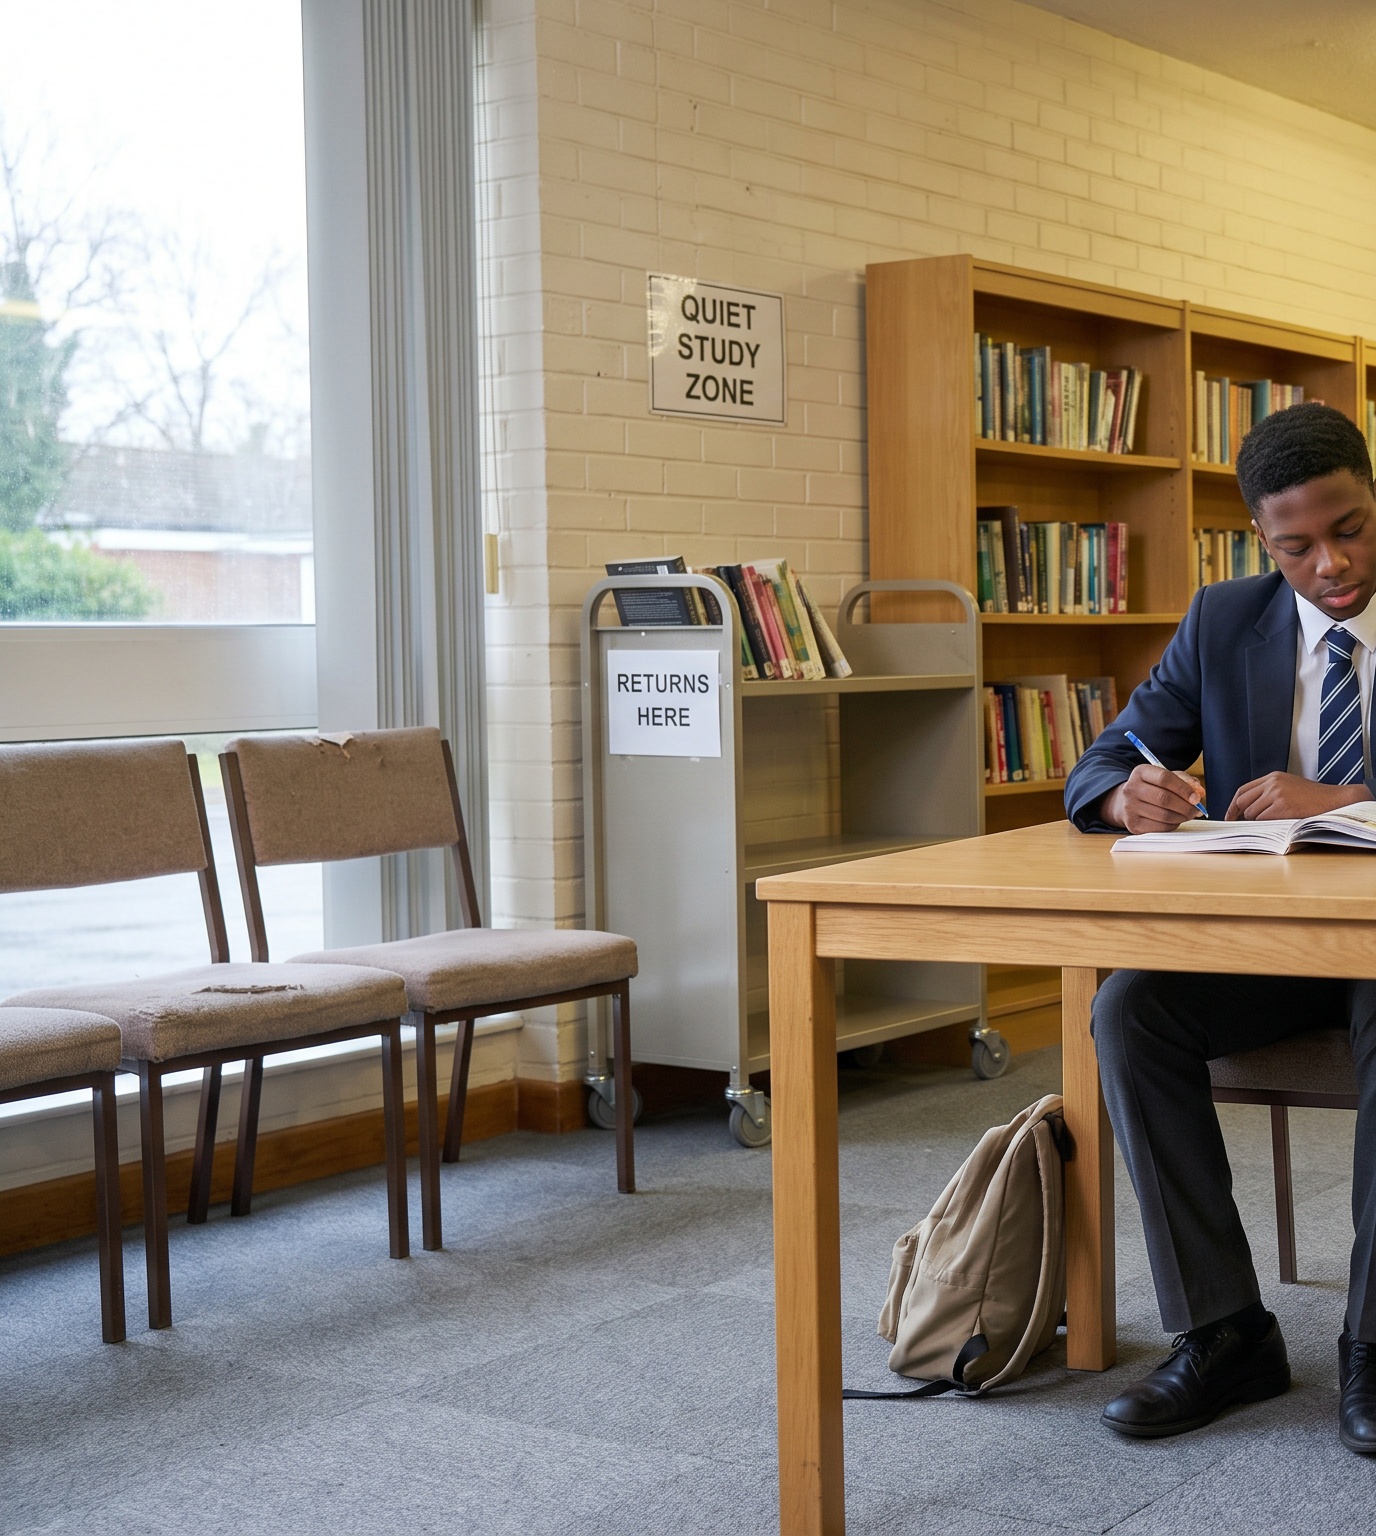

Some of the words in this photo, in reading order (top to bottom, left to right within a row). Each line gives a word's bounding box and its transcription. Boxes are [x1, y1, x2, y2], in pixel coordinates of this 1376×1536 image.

[681, 294, 756, 330] QUIET
[677, 333, 761, 368] STUDY
[685, 372, 754, 406] ZONE
[617, 673, 709, 693] RETURNS
[638, 707, 690, 726] HERE
